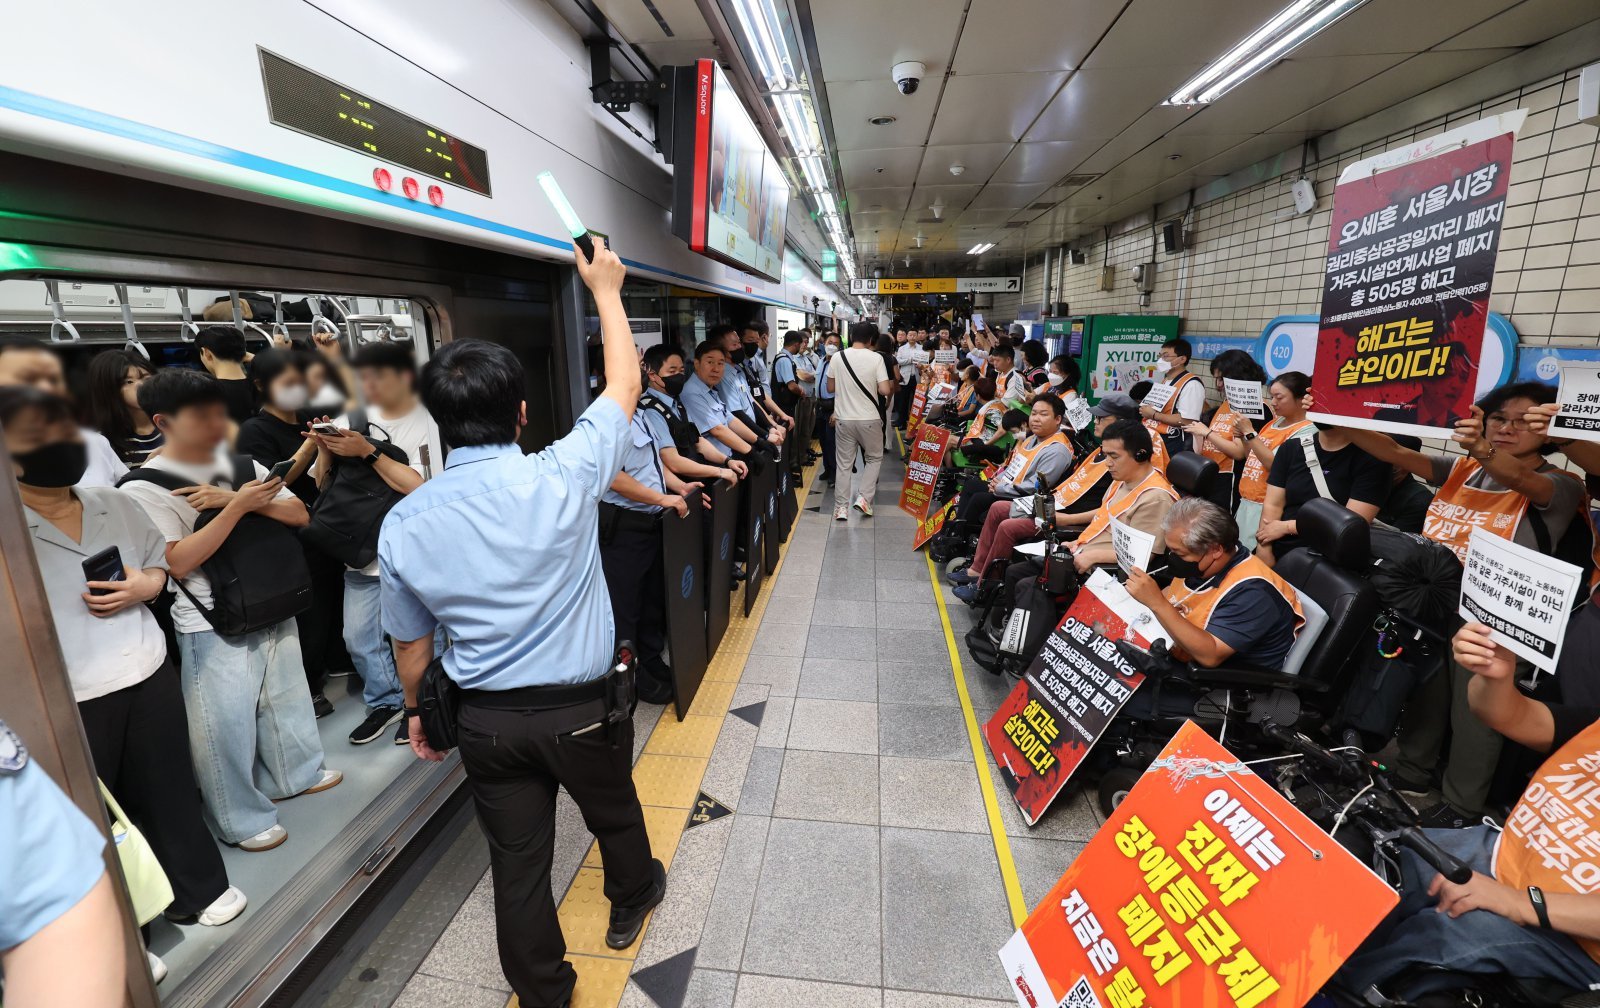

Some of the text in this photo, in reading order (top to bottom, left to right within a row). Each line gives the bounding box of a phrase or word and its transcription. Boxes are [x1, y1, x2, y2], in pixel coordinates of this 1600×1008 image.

[1338, 164, 1498, 246] 오세훈 서울시장
[1326, 201, 1505, 274] 권리중심공공일자리 폐지
[1329, 230, 1496, 292] 거주시설연계사업 폐지
[884, 282, 922, 290] 나가는 곳
[1350, 266, 1455, 307] 총 505명 해고
[1105, 351, 1159, 362] XYLITOL
[1272, 346, 1290, 359] 420
[1356, 315, 1434, 354] 해고는
[1337, 345, 1451, 387] 살인이다!
[1577, 393, 1600, 403] 장애
[1466, 573, 1553, 625] 지역사회에서 함께 살자!
[1479, 564, 1492, 579] 같은
[1493, 572, 1537, 601] 거주시설이
[1541, 594, 1564, 612] 아닌
[1535, 580, 1565, 597] 노동하며
[1008, 612, 1021, 650] SCHNEIDER
[1060, 616, 1094, 645] 오세훈
[1039, 647, 1097, 700] 거주시설연계사업
[1093, 693, 1117, 717] 폐지
[1046, 632, 1111, 689] 권리중심공공일자리
[1105, 679, 1133, 704] 폐지
[1039, 668, 1050, 682] 총
[1046, 674, 1071, 701] 505명
[1066, 695, 1088, 718] 해고
[1003, 714, 1056, 776] 살인이다!
[1022, 698, 1060, 745] 해고는
[691, 800, 716, 821] 5-2
[1202, 787, 1287, 872] 이제는
[1176, 819, 1261, 907] 진짜
[1060, 888, 1119, 977] 지금은
[1114, 814, 1281, 1008] 장애등급제
[1116, 893, 1193, 987] 폐지
